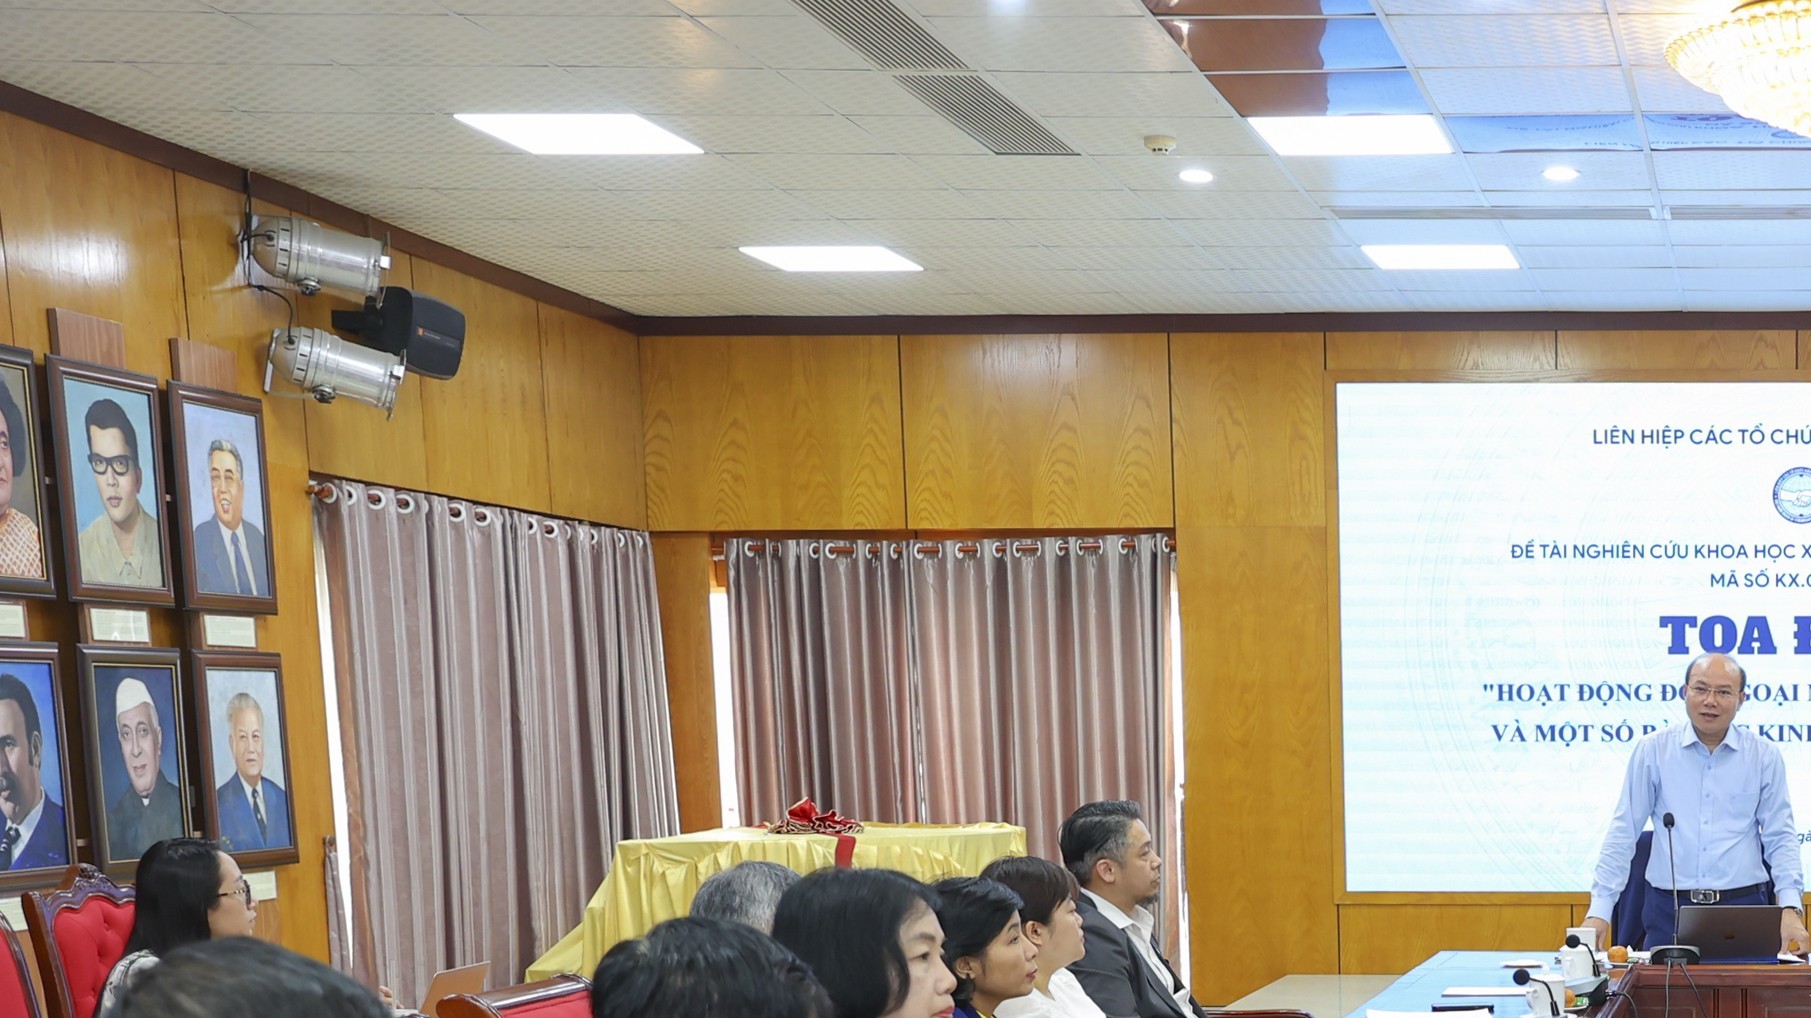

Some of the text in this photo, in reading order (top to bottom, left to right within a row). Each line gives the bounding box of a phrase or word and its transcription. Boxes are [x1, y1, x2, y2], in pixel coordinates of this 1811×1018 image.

[1593, 425, 1635, 445] LIÊN
[1641, 425, 1685, 449] HIỆP
[1689, 425, 1733, 445] CÁC
[1737, 422, 1765, 445] TỔ
[1510, 539, 1535, 559] ĐỀ
[1539, 540, 1567, 559] TÀI
[1573, 540, 1645, 559] NGHIÊN
[1649, 540, 1689, 559] CỨU
[1694, 544, 1749, 559] KHOA
[1754, 544, 1796, 563] HỌC
[1710, 570, 1739, 588] MÃ
[1744, 568, 1770, 588] SỐ
[1483, 683, 1571, 707] "HOẠT
[1578, 680, 1652, 707] ĐỘNG
[1491, 718, 1527, 743] VÀ
[1535, 720, 1595, 748] MỘT
[1601, 718, 1634, 743] SỐ
